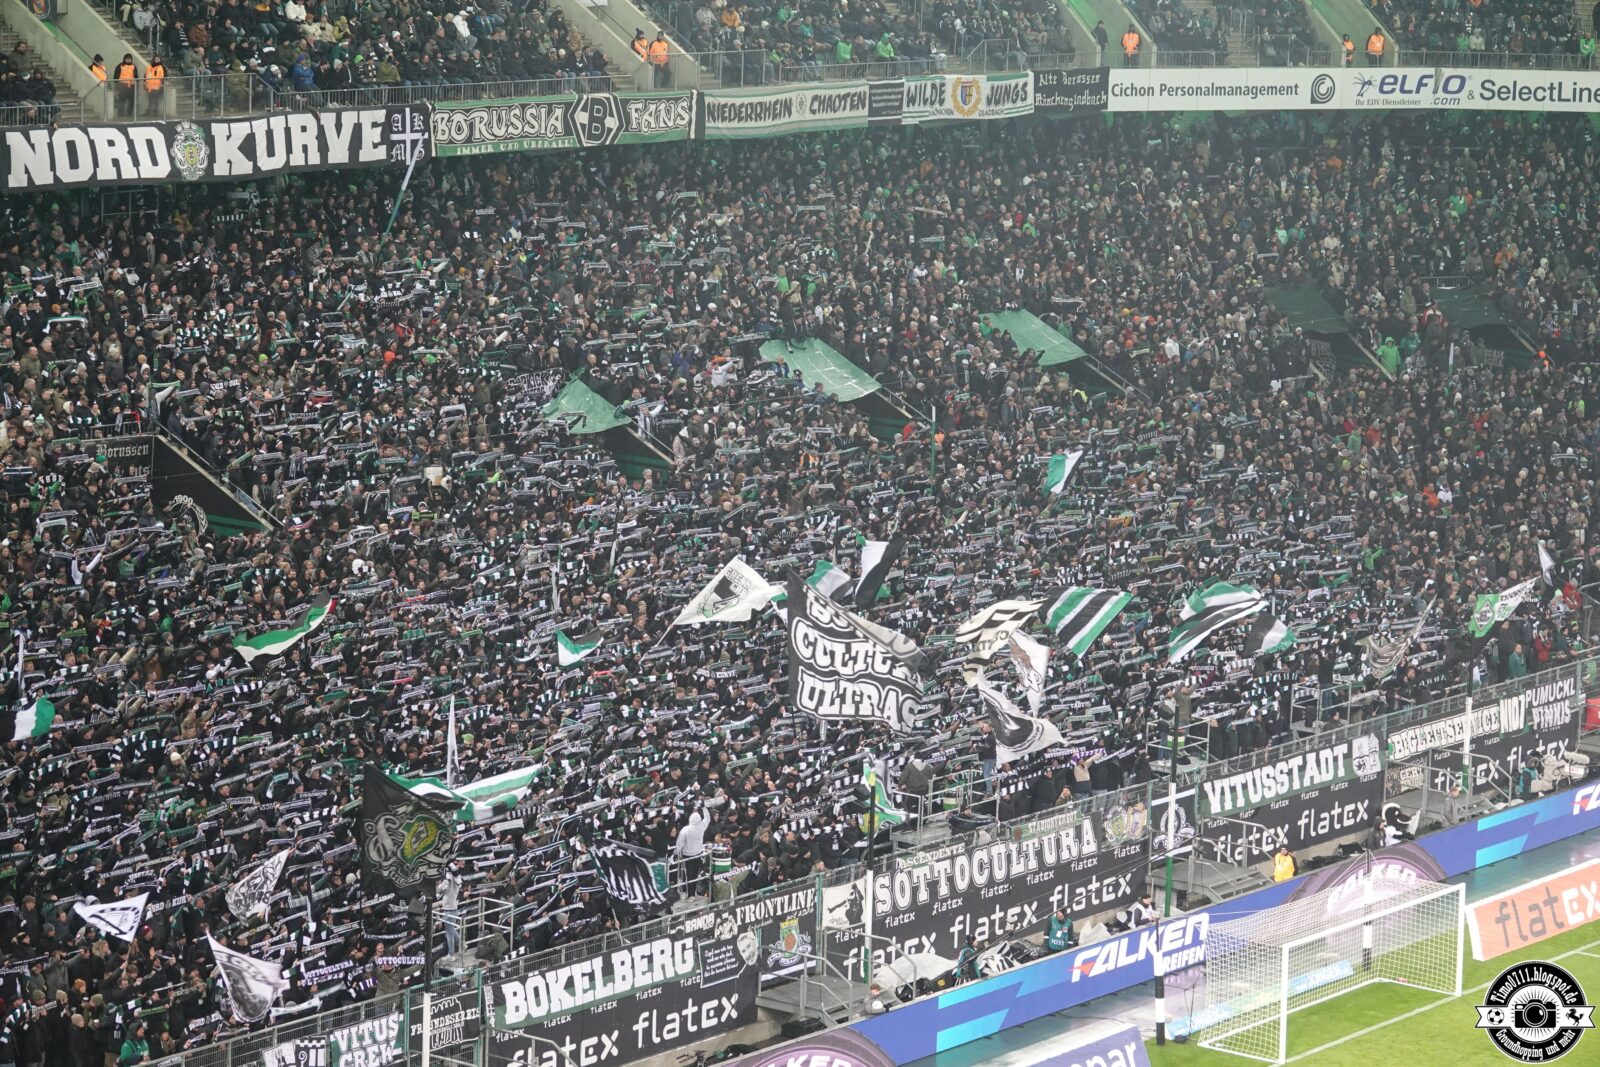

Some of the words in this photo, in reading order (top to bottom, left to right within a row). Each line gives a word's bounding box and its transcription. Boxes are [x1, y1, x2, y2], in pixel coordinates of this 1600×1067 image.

[906, 80, 947, 108] WILDE
[986, 79, 1029, 107] JUNGS
[1111, 82, 1155, 98] Cichon
[1159, 81, 1300, 100] Personalmanagement
[1430, 96, 1461, 106] .com
[627, 97, 691, 133] FANS
[705, 96, 793, 124] NIEDERRHEIN
[808, 90, 867, 115] CHAOTEN
[434, 103, 566, 144] BORUSSIA
[6, 127, 171, 188] NORD
[211, 109, 387, 176] KURVE
[1525, 678, 1576, 709] PUMUCKL
[1203, 743, 1348, 814] VITUSSTADT
[1330, 781, 1349, 792] flatex
[1270, 799, 1289, 810] flatex
[1301, 789, 1319, 801] flatex
[1298, 799, 1369, 841] flatex
[1113, 843, 1140, 859] flatex
[1213, 823, 1290, 863] flatex
[873, 816, 1098, 917] SOTTOCULTURA
[1026, 870, 1055, 885] flatex
[1070, 857, 1098, 872] flatex
[735, 887, 816, 926] FRONTLINE
[933, 897, 963, 914] flatex
[981, 884, 1011, 899] flatex
[1048, 872, 1132, 915] flatex
[885, 911, 915, 928] flatex
[949, 901, 1038, 949] flatex
[1494, 880, 1600, 948] flatex
[1070, 912, 1210, 983] FALKEN
[502, 937, 695, 1025] BÖKELBERG
[635, 986, 663, 1000] flatex
[543, 1014, 571, 1029] flatex
[590, 1000, 618, 1014] flatex
[633, 993, 739, 1048] flatex
[333, 1011, 400, 1052] VITUS
[338, 1039, 398, 1067] CREW
